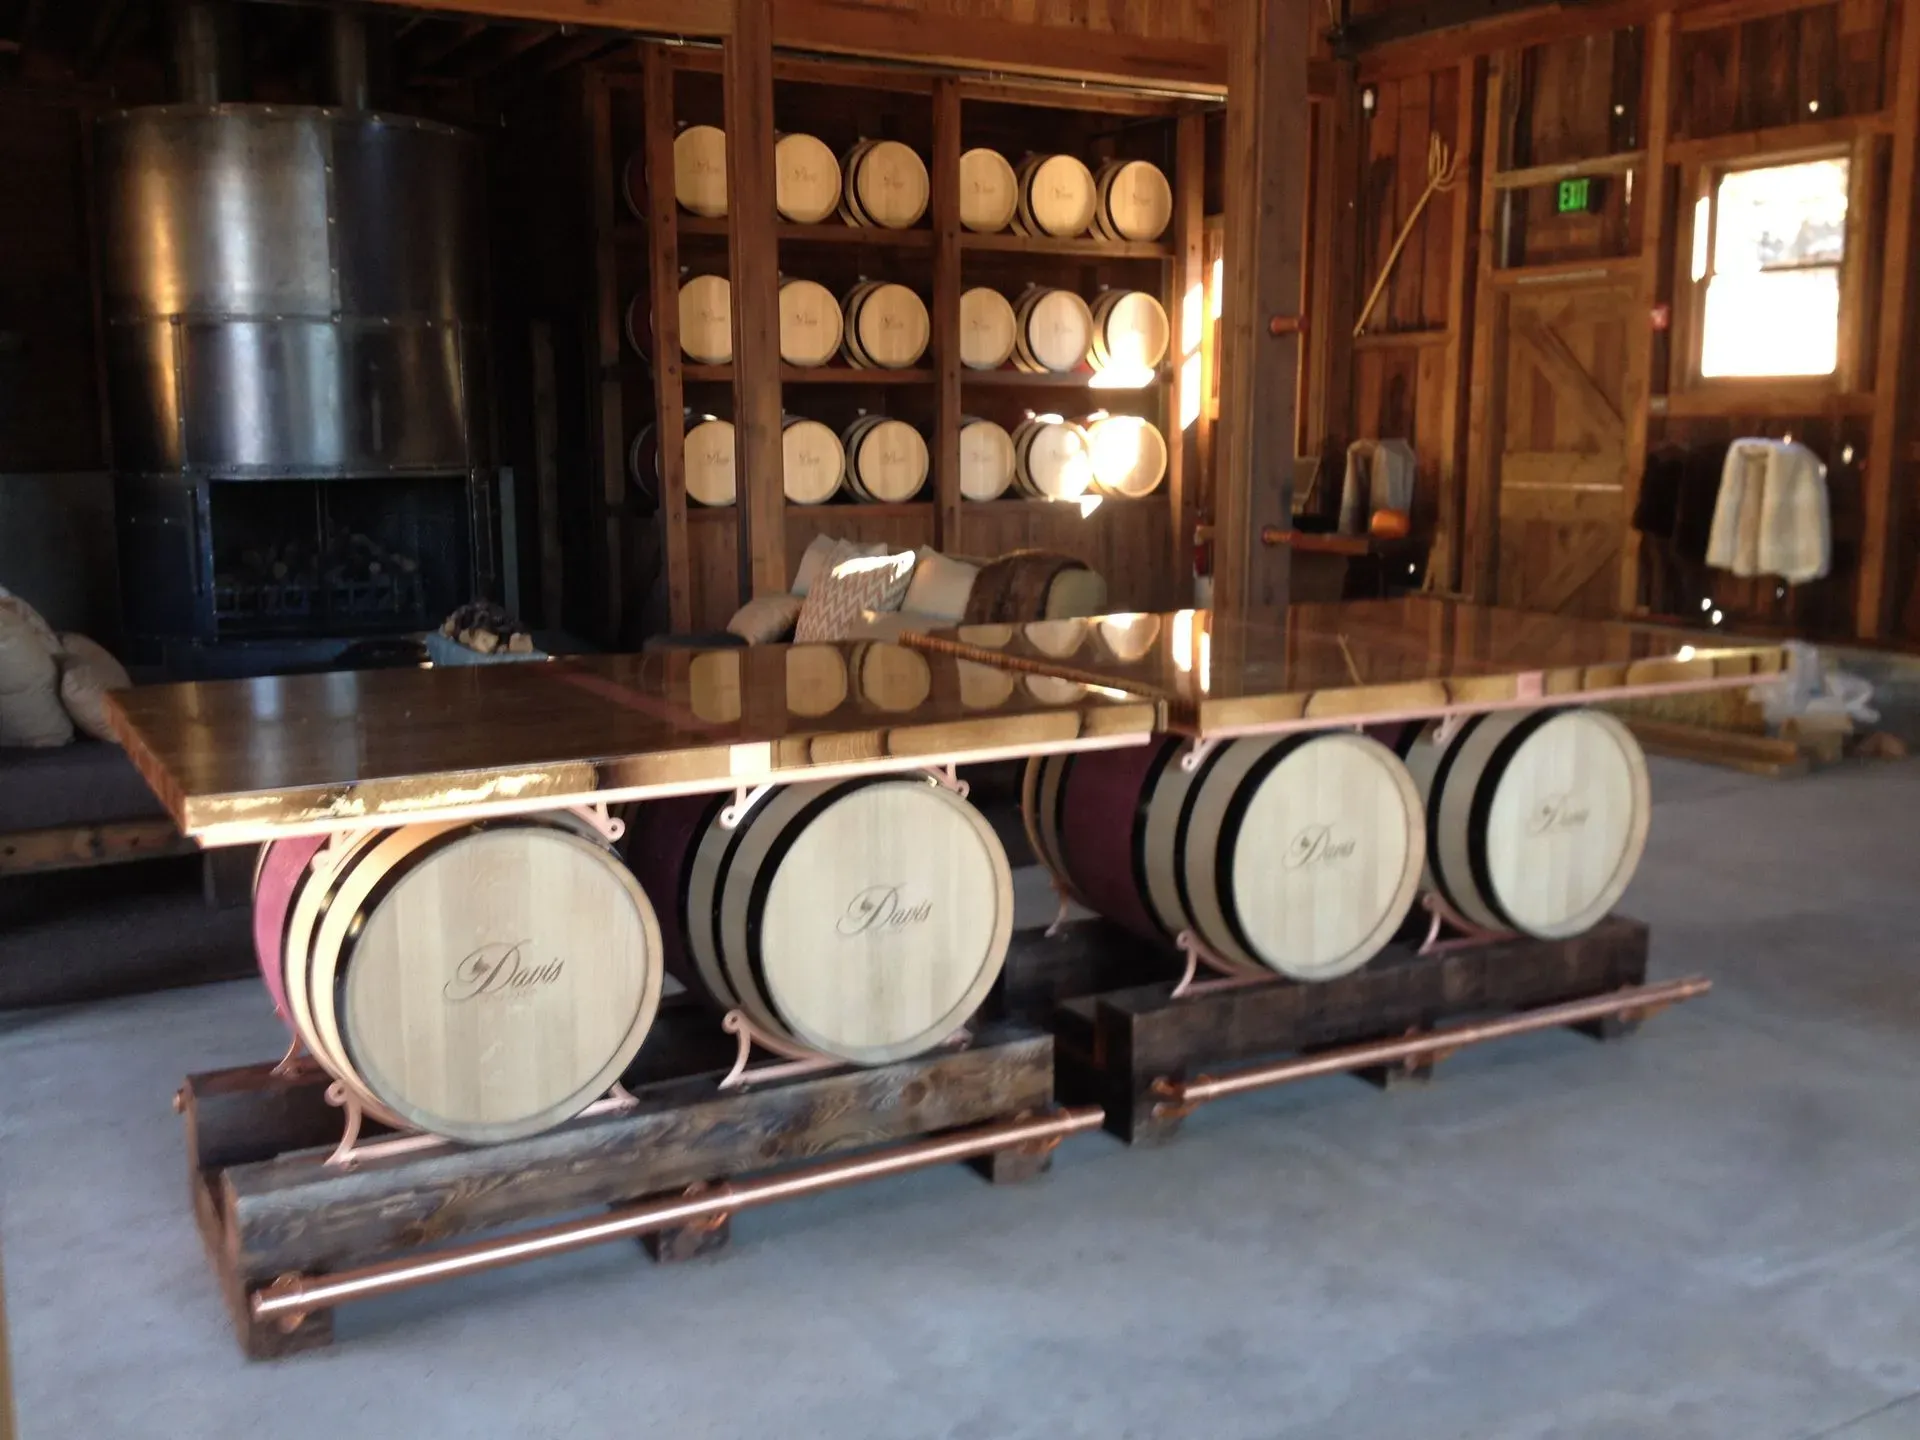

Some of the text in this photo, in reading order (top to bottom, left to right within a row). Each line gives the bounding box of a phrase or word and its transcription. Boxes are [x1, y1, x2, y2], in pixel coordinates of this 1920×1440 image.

[1559, 178, 1589, 212] EXIT
[1282, 821, 1356, 870] Davis
[836, 881, 932, 936] Davis
[443, 938, 565, 1001] Davis
